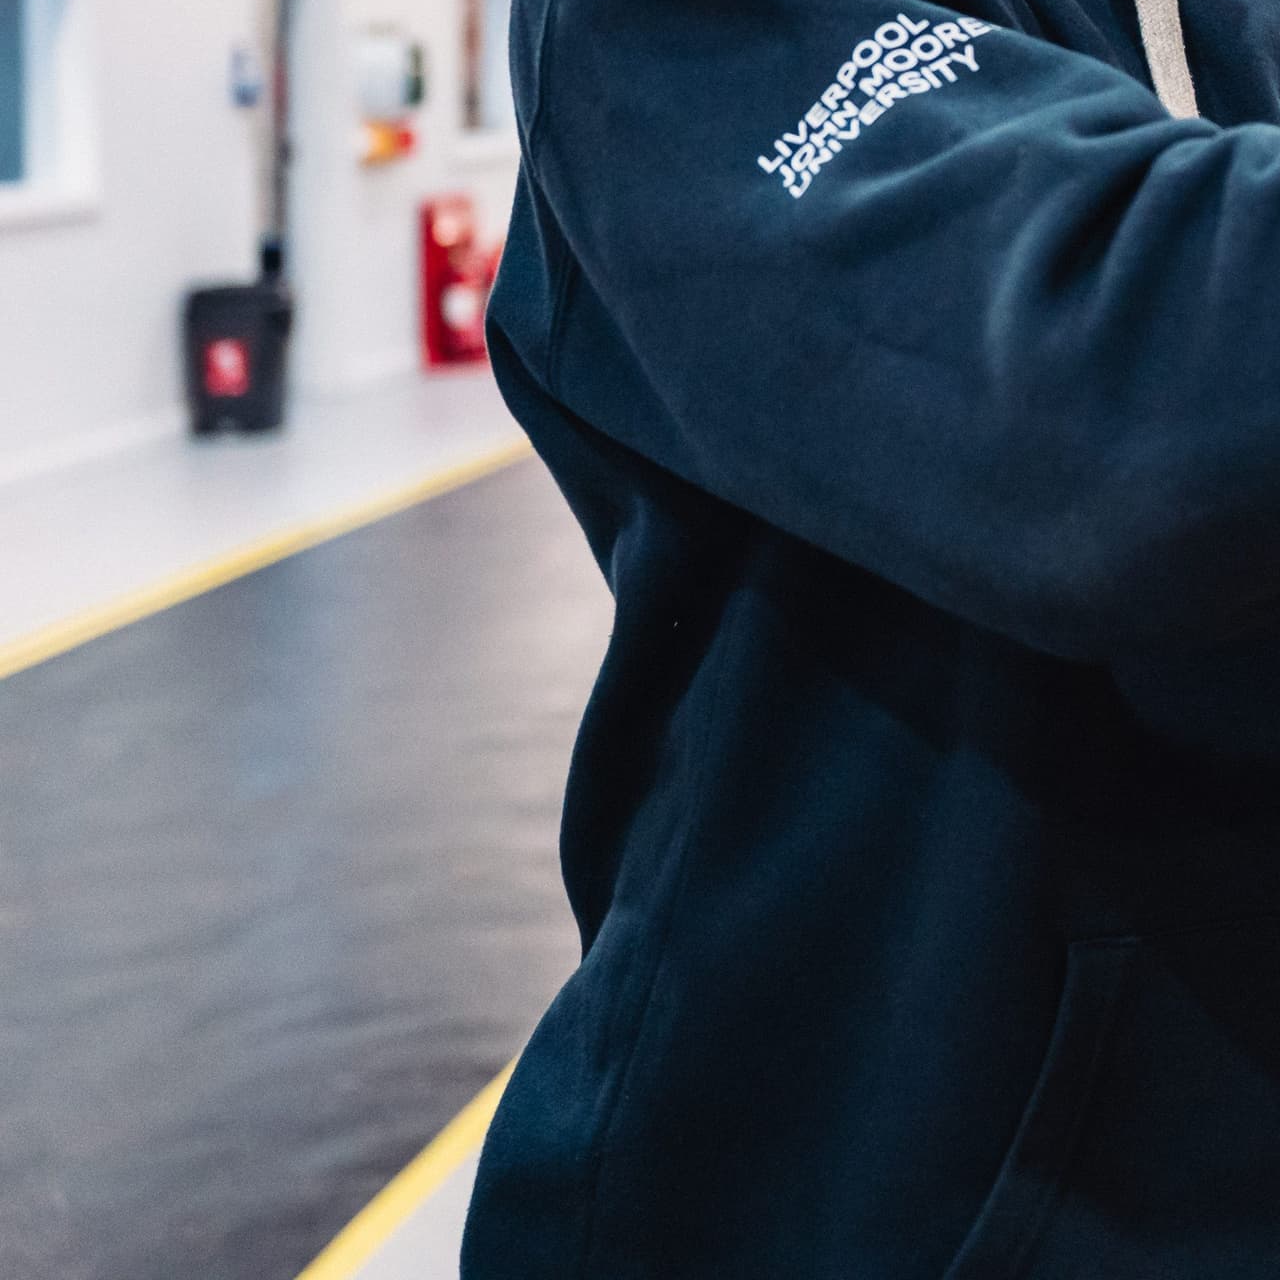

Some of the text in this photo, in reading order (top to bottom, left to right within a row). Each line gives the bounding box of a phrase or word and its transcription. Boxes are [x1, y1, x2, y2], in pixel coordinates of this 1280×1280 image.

[757, 13, 930, 175] LIVERPOOL
[779, 17, 1003, 188] JOHN MOORE
[788, 44, 981, 199] UNIVERSITY
